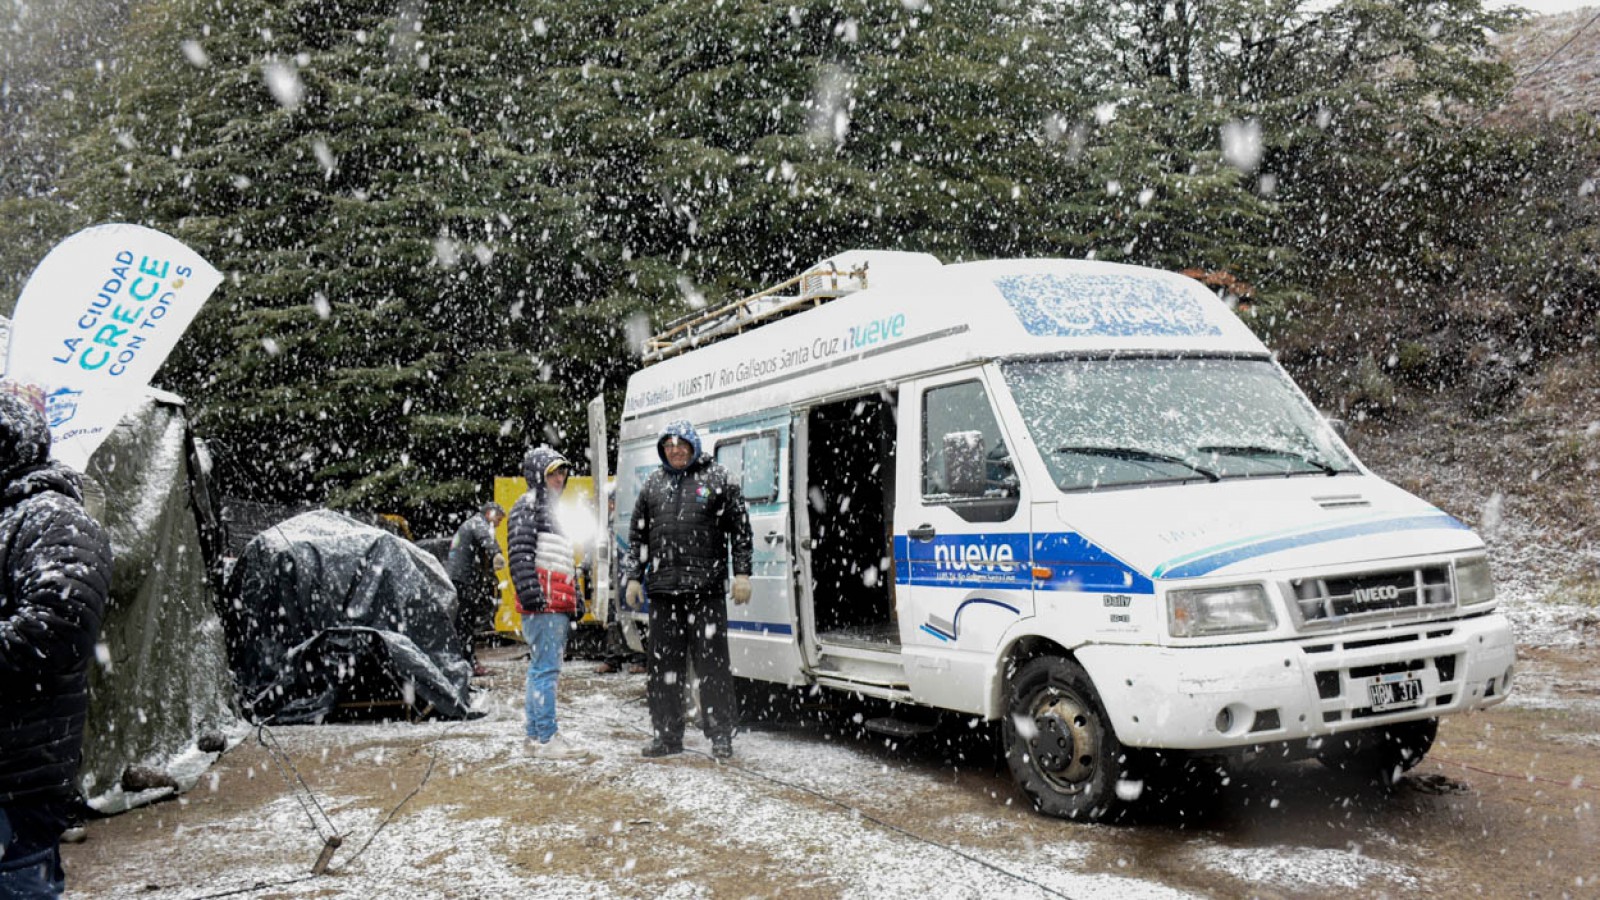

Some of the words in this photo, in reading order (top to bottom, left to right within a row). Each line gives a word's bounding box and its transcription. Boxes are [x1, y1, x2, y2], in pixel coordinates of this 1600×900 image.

[52, 337, 83, 364] LA
[78, 250, 134, 329] CIUDAD
[78, 255, 170, 371] CRECE
[109, 335, 146, 376] CON
[704, 371, 716, 391] TV
[780, 346, 809, 370] Santa
[812, 337, 839, 360] Cruz
[934, 543, 1014, 572] nueve
[1103, 594, 1132, 608] Daily
[1354, 584, 1399, 604] IVECO
